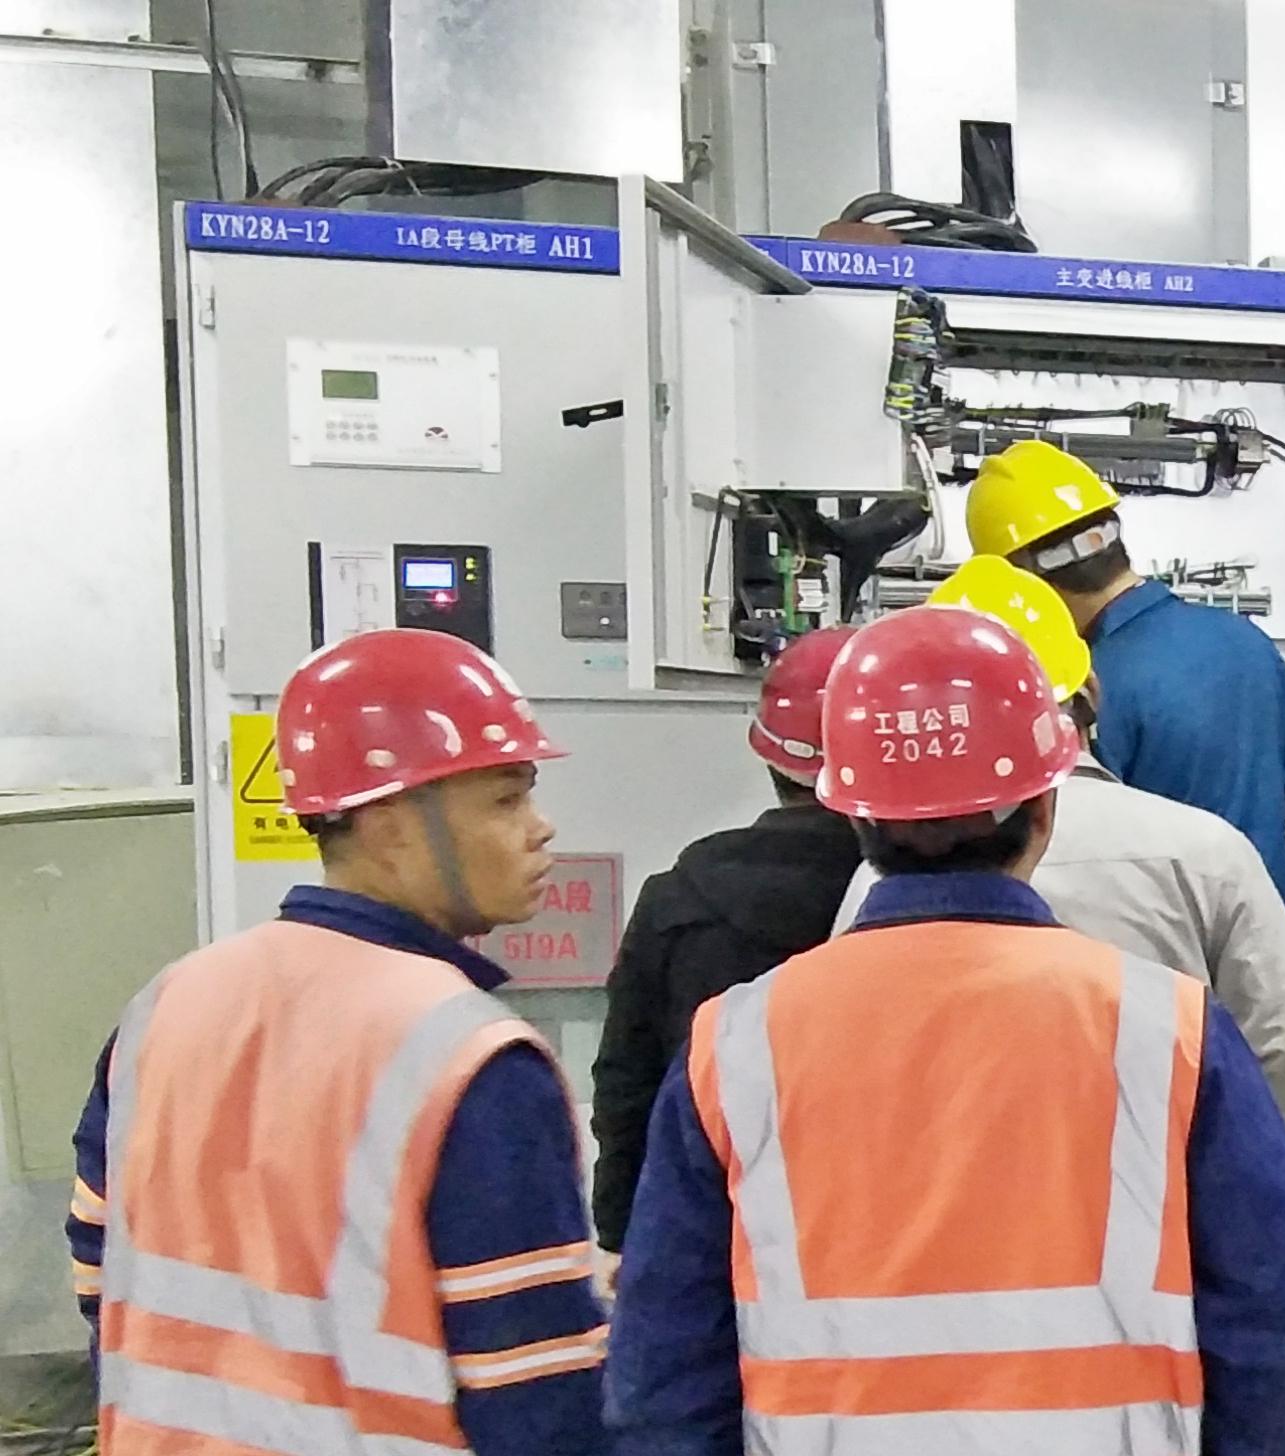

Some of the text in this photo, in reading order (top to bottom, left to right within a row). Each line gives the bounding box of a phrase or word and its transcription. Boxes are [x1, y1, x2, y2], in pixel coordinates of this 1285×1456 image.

[202, 212, 331, 243] KYN28A-12
[549, 235, 593, 259] AH1
[801, 249, 915, 278] KYN28A-12
[1056, 267, 1152, 290] 主变进线柜
[1164, 276, 1195, 292] AH2
[873, 704, 970, 735] 工程公司
[880, 732, 968, 763] 2042
